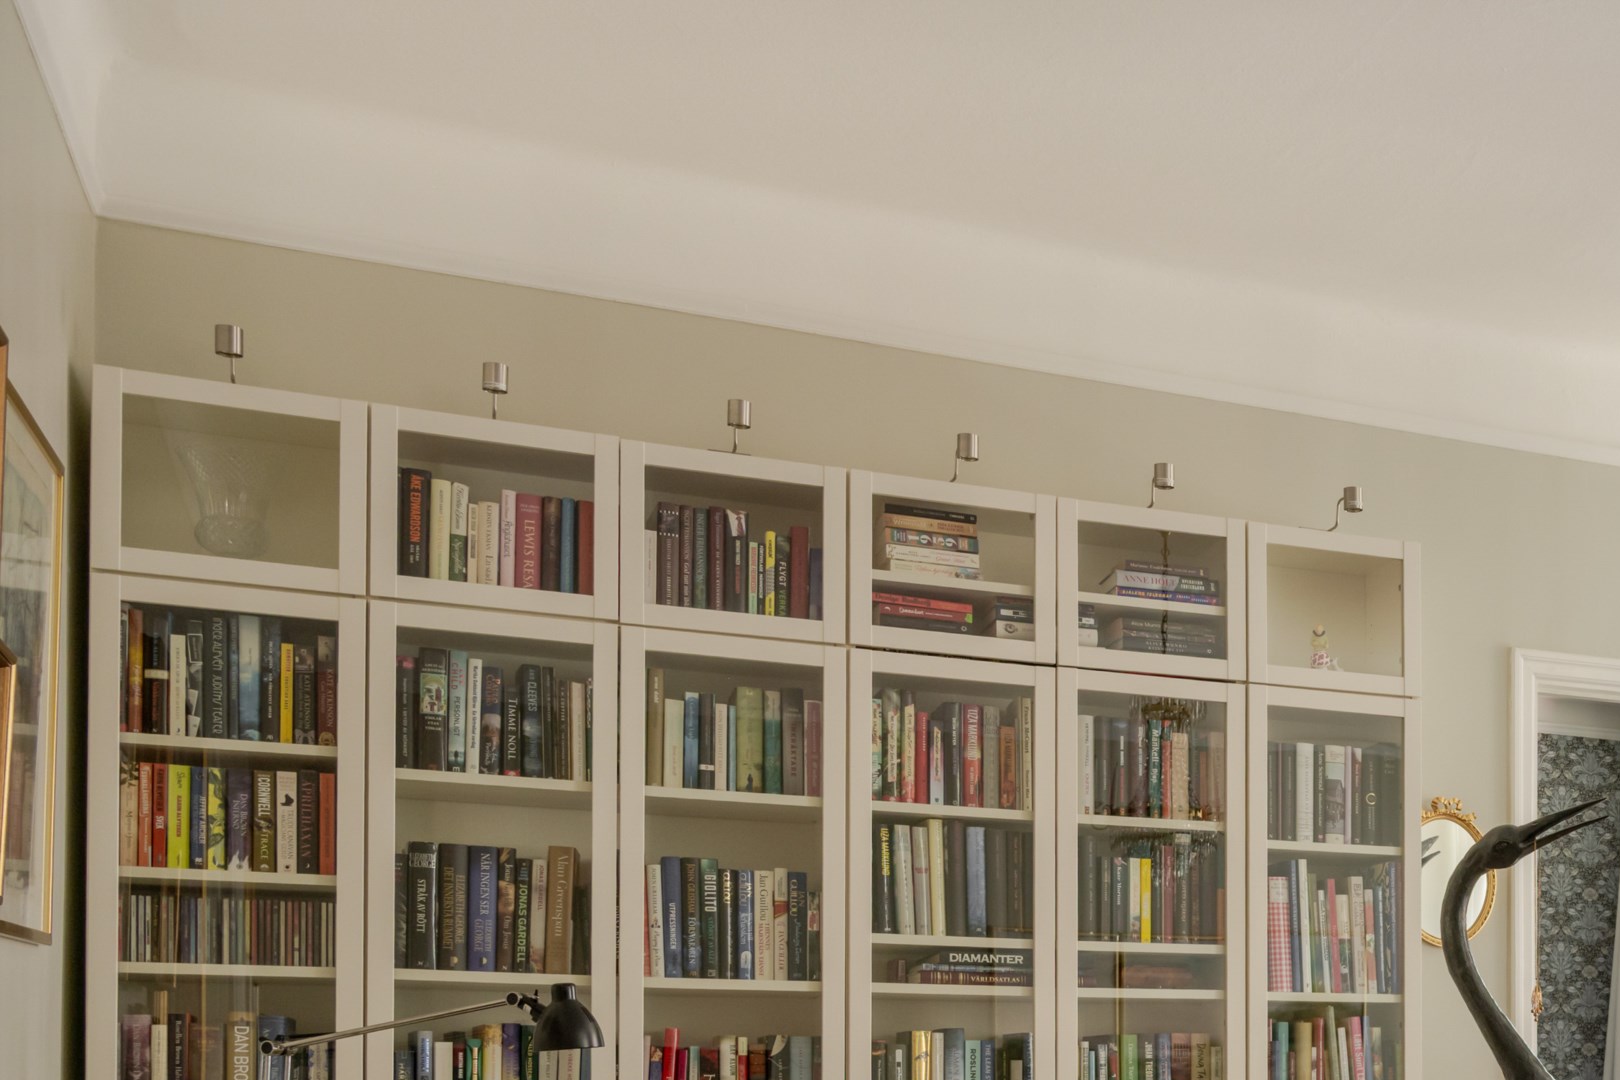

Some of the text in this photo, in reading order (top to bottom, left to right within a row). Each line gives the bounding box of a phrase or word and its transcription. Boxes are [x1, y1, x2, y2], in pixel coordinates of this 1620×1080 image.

[410, 475, 424, 542] ÅKE EDWARDSON
[696, 514, 705, 536] INGER
[522, 519, 536, 556] LEWIS
[522, 560, 536, 589] RESA
[779, 561, 787, 587] FLYGT
[1122, 575, 1148, 585] ANNE
[211, 641, 225, 671] ALFVÉN
[211, 674, 224, 706] JUDITHS
[451, 662, 459, 691] CHILD
[303, 674, 312, 731] KATE ATKINSON
[326, 668, 336, 728] KATE ATKINSON
[527, 681, 538, 712] CLEEVES
[211, 706, 223, 735] TEATER
[453, 696, 461, 737] PERSONLIGT
[508, 698, 518, 761] TIMME NOLL
[967, 708, 978, 761] LIZA MARKLUND
[1151, 729, 1161, 763] Mankell
[199, 794, 207, 819] JEFFREY
[239, 793, 248, 837] DAN BROWN
[256, 776, 271, 818] CORNWELL
[301, 779, 313, 859] APRILHÄXAN
[260, 832, 270, 861] TRACE
[880, 828, 891, 876] LIZA MARKLUND
[479, 853, 492, 915] NÄR INGEN SER
[687, 863, 696, 882] JOHN
[739, 871, 748, 906] GUILLOU
[416, 879, 428, 934] STRÅK AV RÖTT
[442, 866, 454, 951] DET INNERSTA RUMMET
[455, 874, 466, 944] ELIZABETH GEORGE
[503, 863, 513, 950] Jonas Om Jesus
[551, 855, 569, 938] Alan Greenspan
[704, 874, 717, 912] GIOLITO
[759, 873, 769, 922] Jan Guillou
[789, 879, 798, 917] GUILLOU
[797, 891, 805, 907] JAN
[473, 918, 485, 953] GEORGE
[484, 919, 493, 952] ELIZABETH
[516, 883, 528, 964] JONAS GARDELL
[669, 902, 677, 950] UTPRESSNINGEN
[687, 916, 698, 964] FÖRSVARAREN
[949, 952, 1025, 965] DIAMANTER
[970, 974, 1021, 983] VÄRLDSATLAS
[233, 1025, 250, 1052] DAN
[1144, 1041, 1154, 1059] JOHAN
[1352, 1033, 1362, 1051] Lätt
[1354, 1052, 1364, 1072] Sunt
